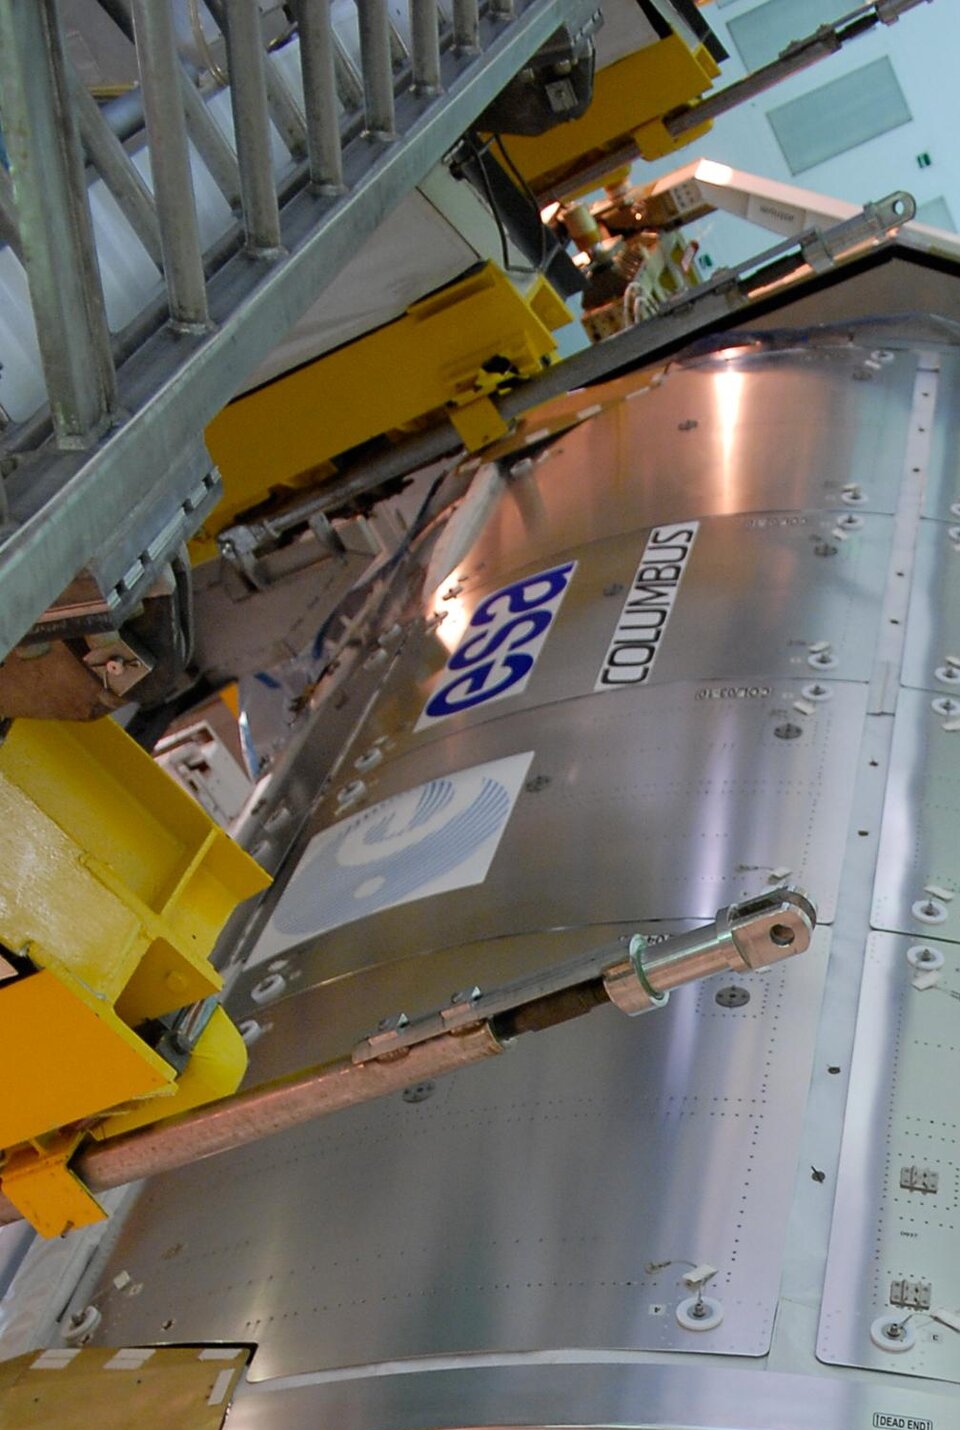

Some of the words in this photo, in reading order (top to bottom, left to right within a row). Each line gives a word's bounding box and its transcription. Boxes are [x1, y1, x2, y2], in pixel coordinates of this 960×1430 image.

[425, 560, 576, 718] esa
[601, 529, 694, 684] COLUMBUS
[880, 1415, 905, 1429] DEAD
